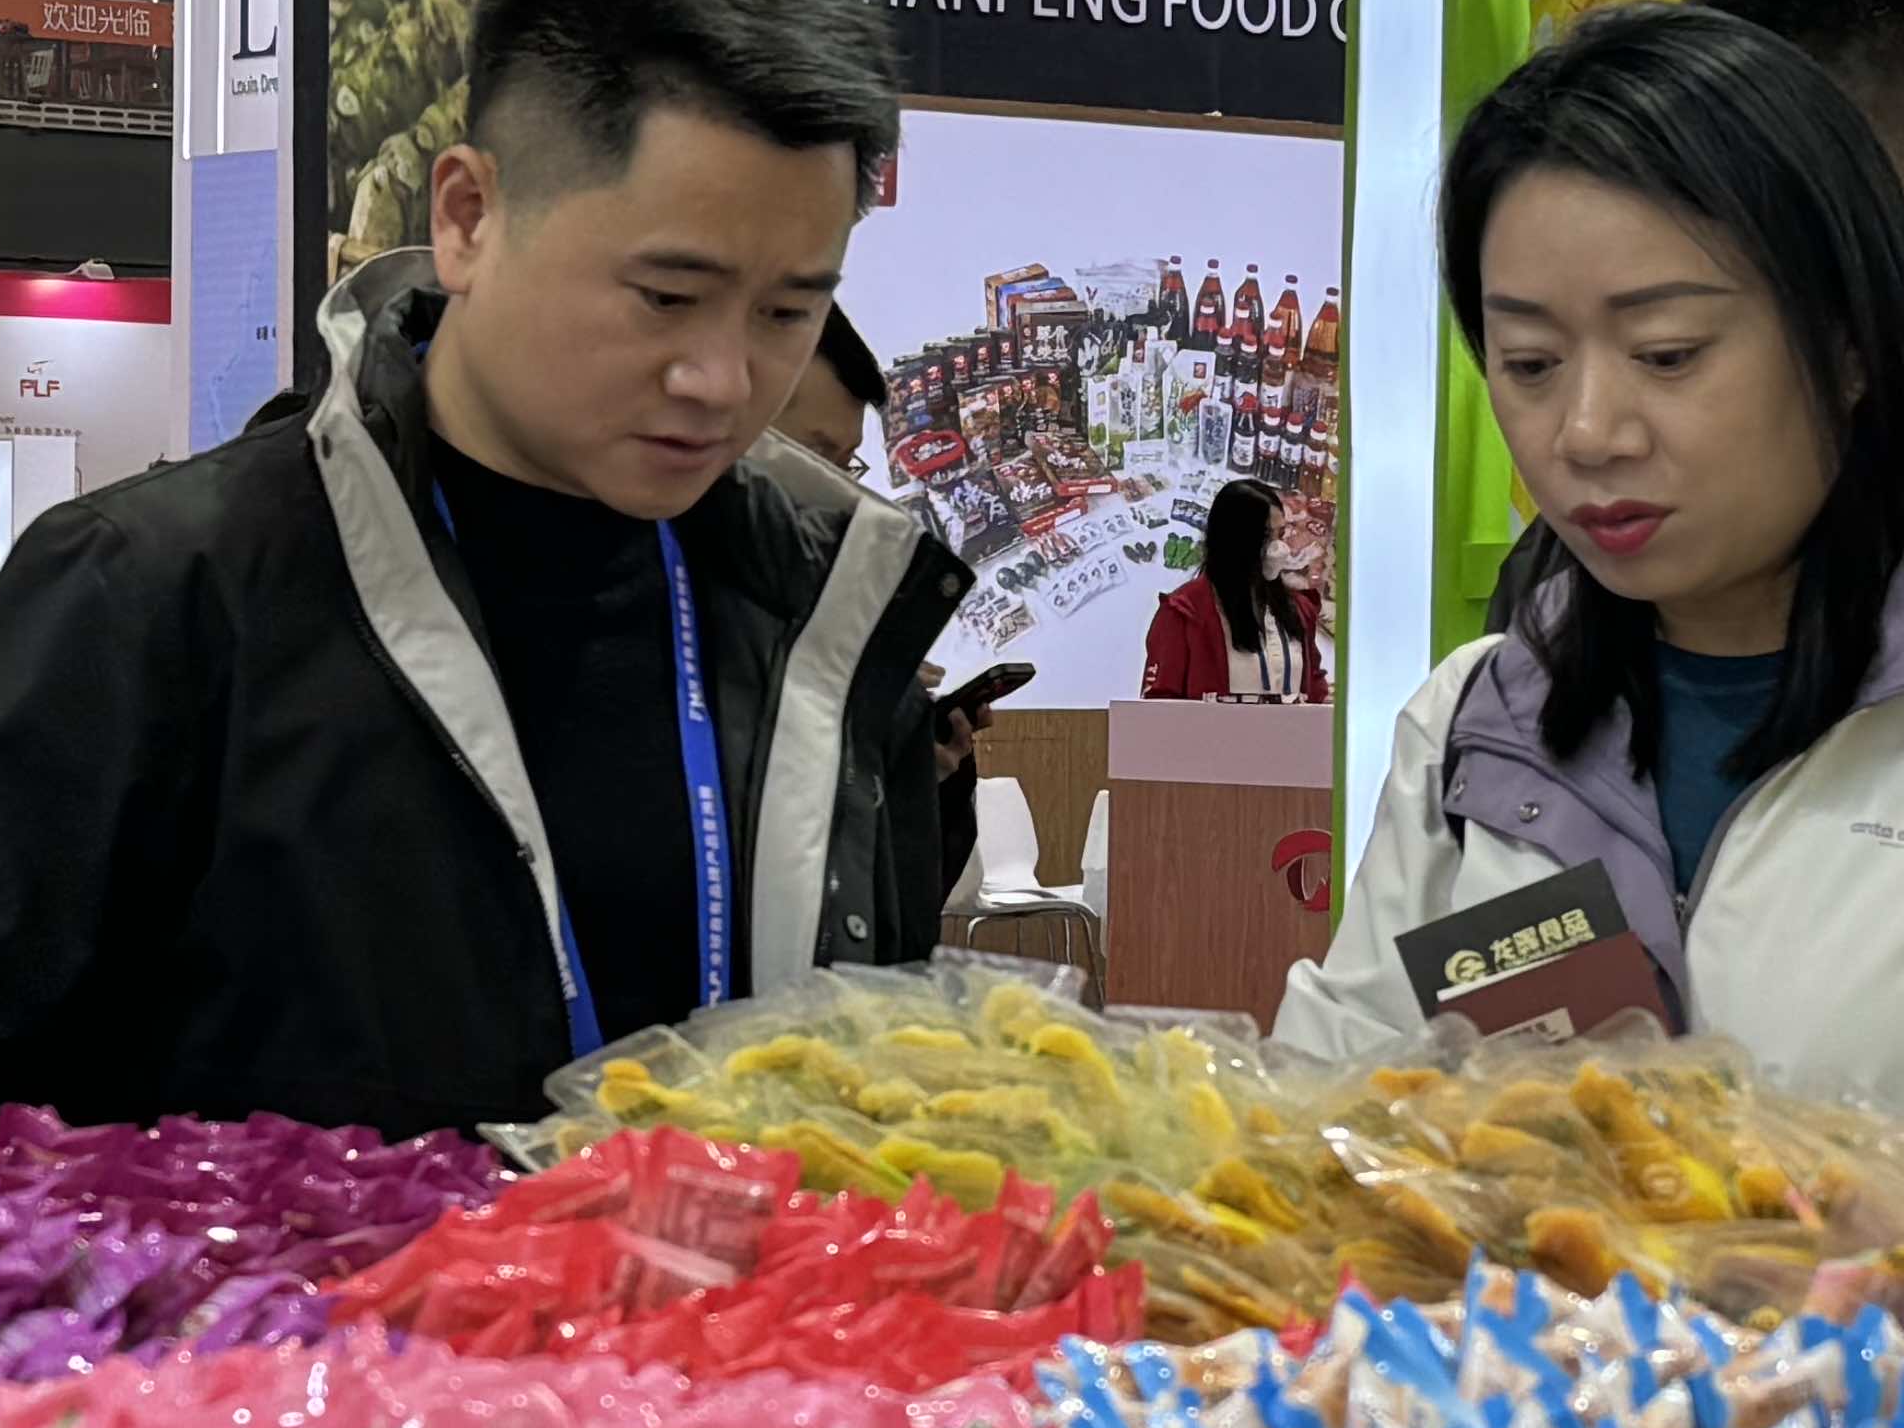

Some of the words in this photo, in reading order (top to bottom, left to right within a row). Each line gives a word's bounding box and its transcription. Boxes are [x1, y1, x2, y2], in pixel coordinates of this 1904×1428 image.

[42, 1, 151, 38] 欢迎光临
[19, 379, 60, 398] PLF
